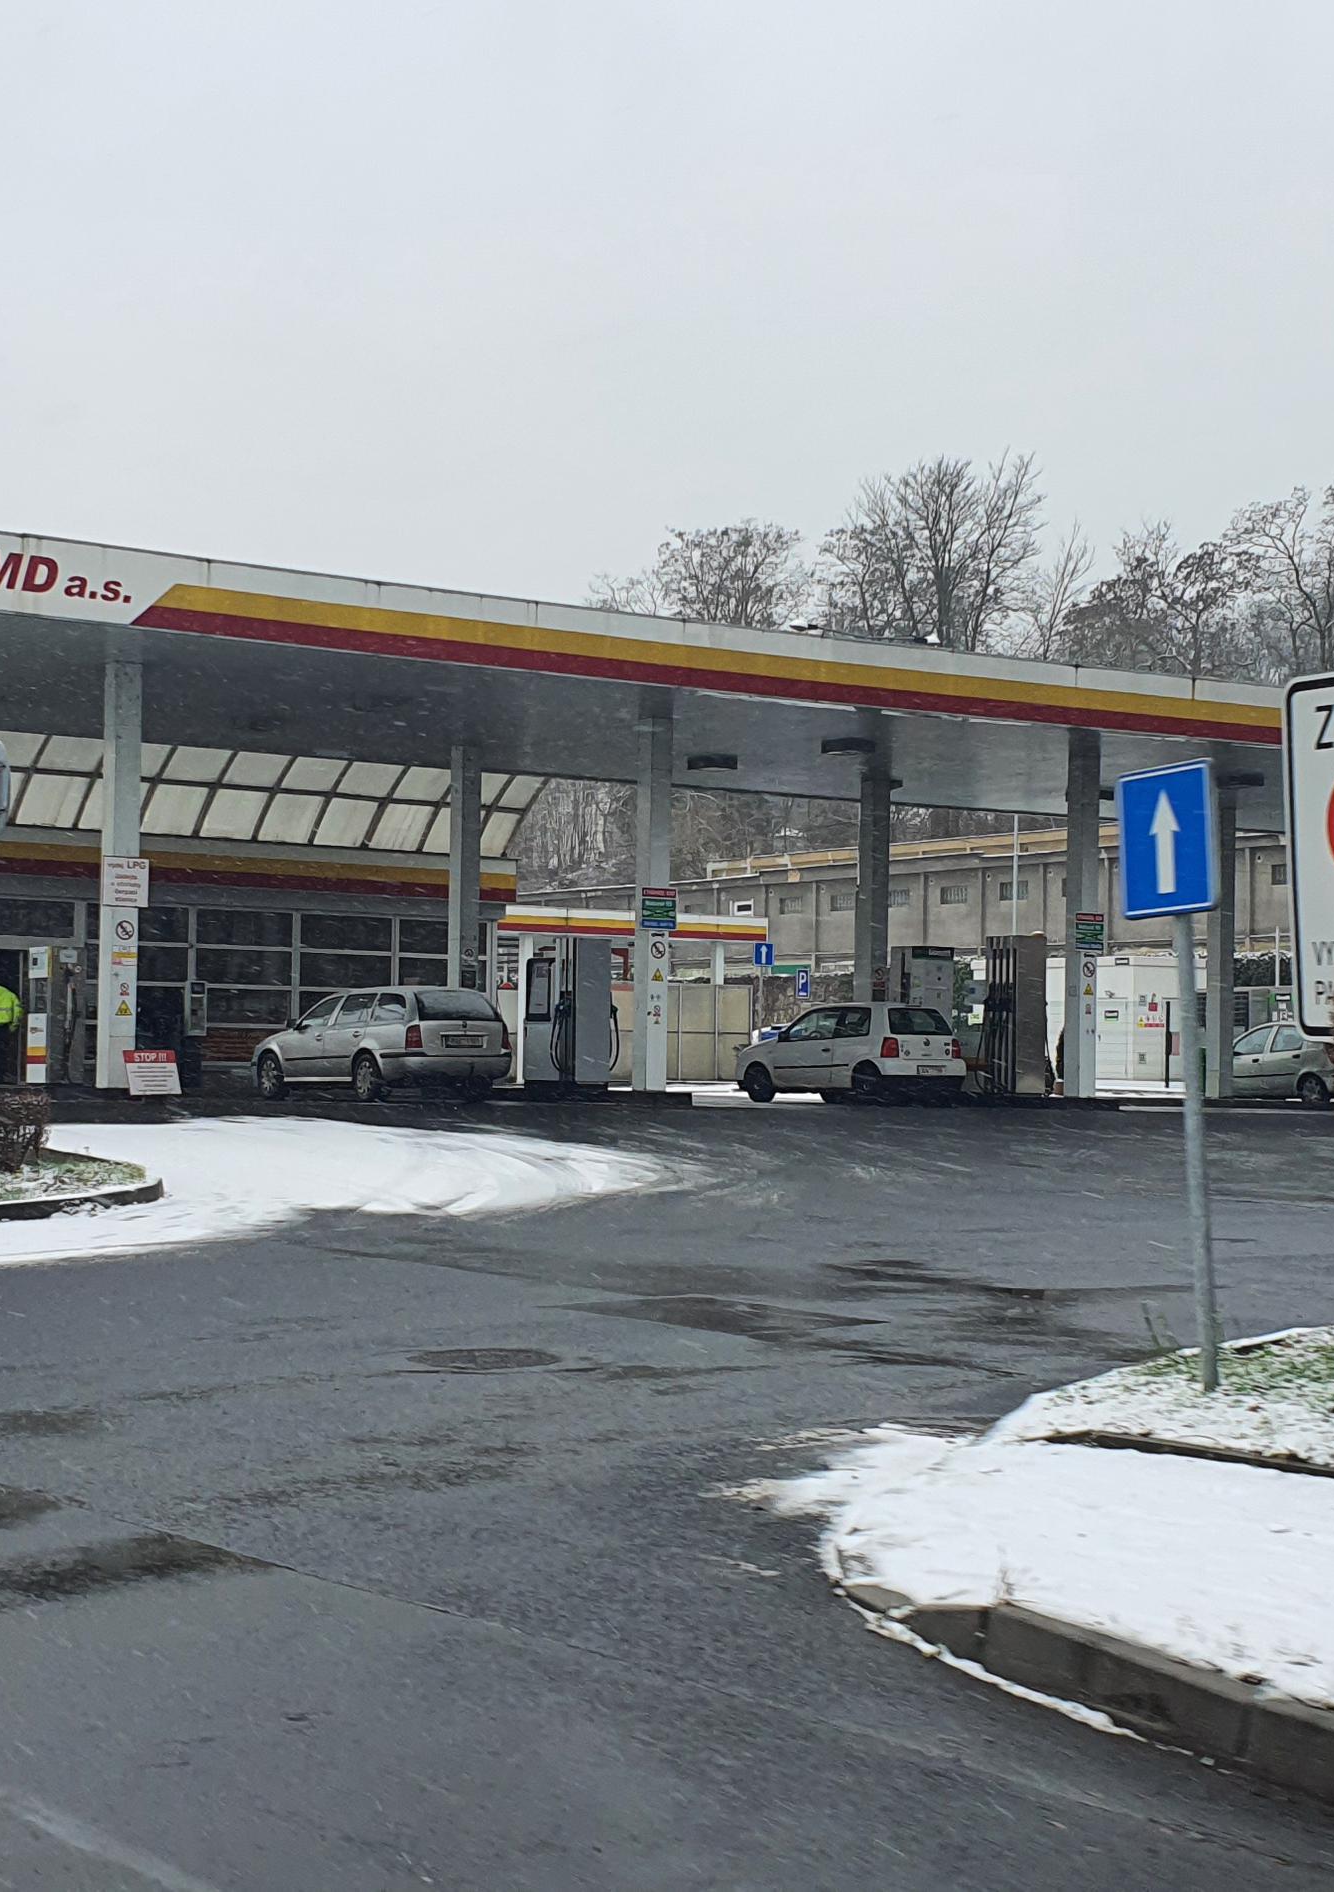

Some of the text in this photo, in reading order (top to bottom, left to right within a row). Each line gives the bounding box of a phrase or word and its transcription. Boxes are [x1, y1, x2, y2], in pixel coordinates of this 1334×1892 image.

[64, 575, 132, 604] a.s.
[127, 861, 146, 869] LPG
[799, 972, 807, 989] P
[134, 1052, 156, 1062] STOP
